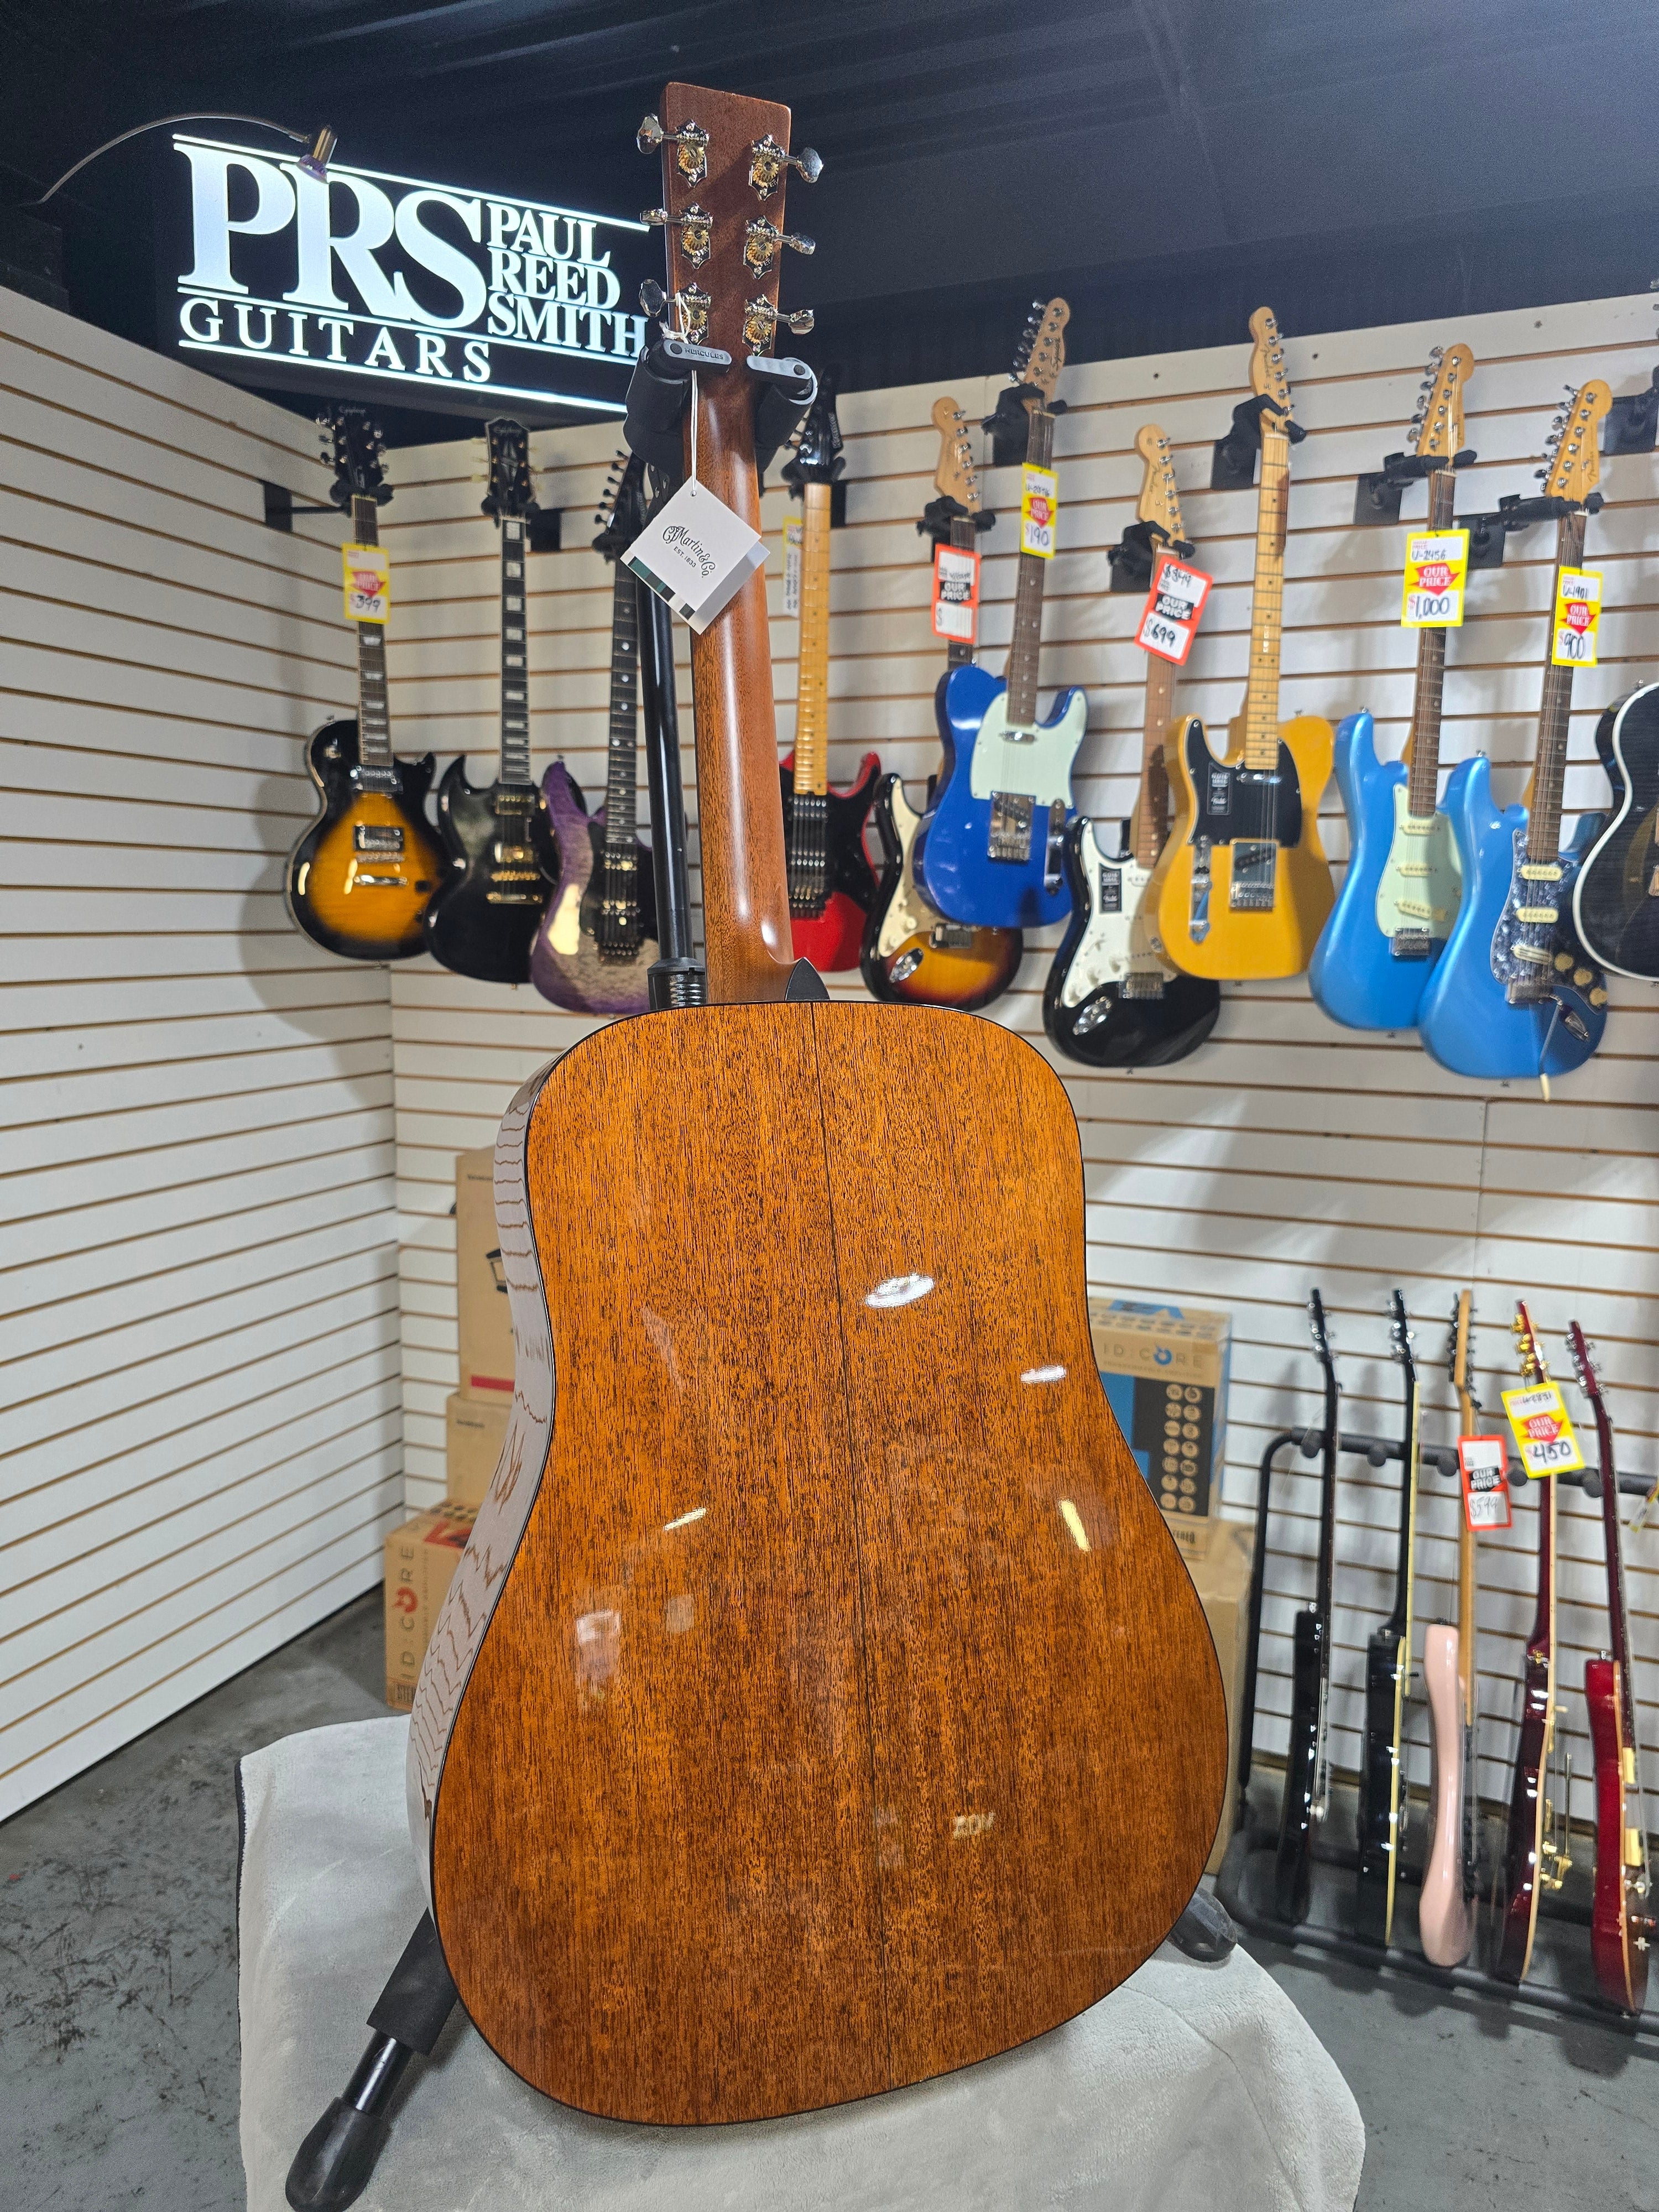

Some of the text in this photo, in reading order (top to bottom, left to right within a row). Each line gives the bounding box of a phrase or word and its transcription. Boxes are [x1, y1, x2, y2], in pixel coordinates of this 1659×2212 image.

[174, 143, 487, 328] PRS
[486, 202, 611, 268] PAUL
[487, 247, 620, 310] REED
[487, 293, 649, 357] SMITH
[179, 297, 491, 383] GUITARS
[685, 347, 724, 360] HERCULES
[1030, 508, 1049, 521] PRICE
[673, 546, 697, 568] EST. 1833
[1423, 565, 1449, 577] OUR
[944, 582, 966, 592] OUR
[1419, 576, 1453, 588] PRICE
[941, 590, 971, 601] PRICE
[1162, 594, 1188, 610] OUR
[1155, 601, 1192, 620] PRICE
[1570, 603, 1589, 615] OUR
[1566, 614, 1591, 627] PRICE
[1143, 618, 1176, 648] $699
[1528, 1416, 1553, 1428] OUR
[1527, 1423, 1559, 1439] PRICE
[1472, 1467, 1495, 1480] OUR
[1470, 1474, 1501, 1491] PRICE
